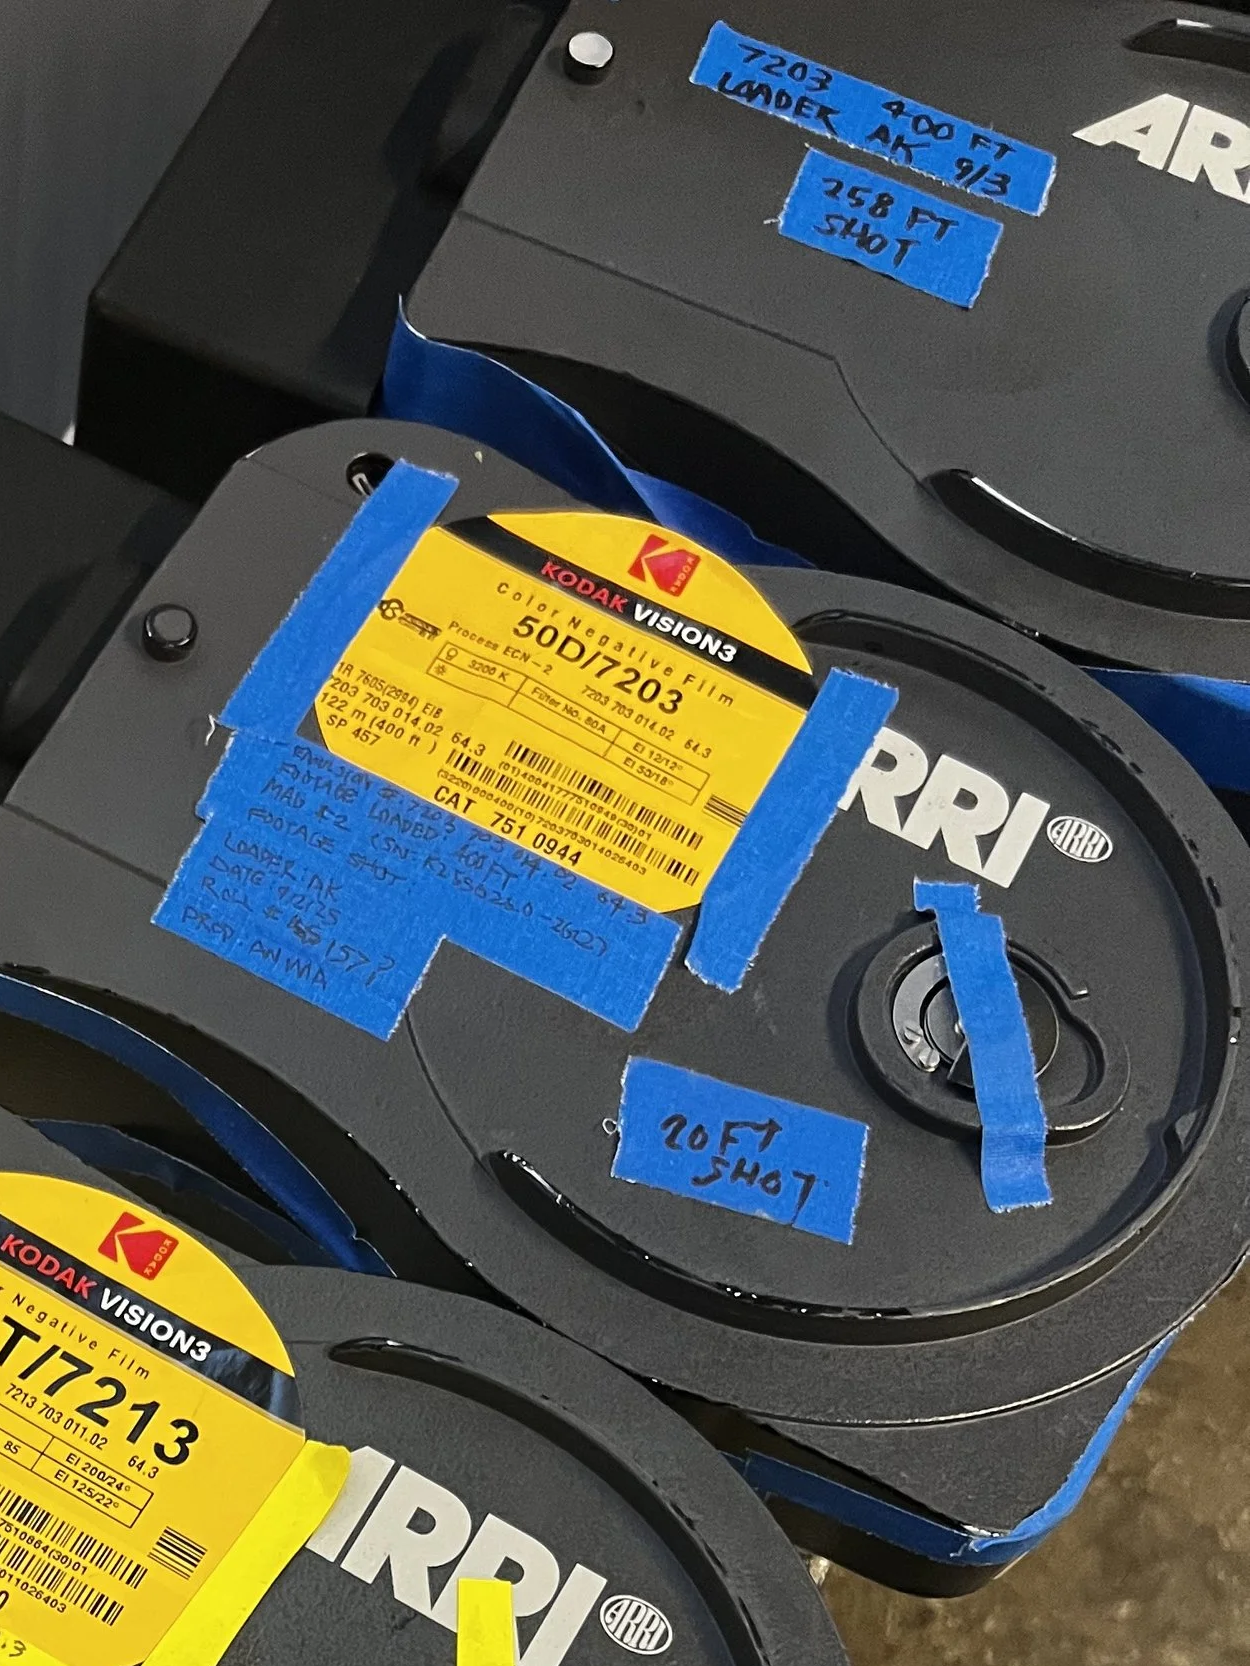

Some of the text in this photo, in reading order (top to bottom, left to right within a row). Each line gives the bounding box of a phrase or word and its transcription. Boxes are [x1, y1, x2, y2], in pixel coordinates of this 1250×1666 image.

[713, 69, 1013, 200] LOADER AK 9/3
[733, 42, 1019, 167] 7203 400 FT
[810, 207, 921, 274] SHOT
[816, 172, 960, 246] 258 FT
[668, 554, 698, 597] KODAK
[447, 620, 498, 651] Process
[496, 582, 733, 706] Color Negative Film
[542, 562, 736, 661] KODAK VISION3
[355, 669, 419, 710] 7605(2994)
[497, 671, 509, 681] K
[512, 615, 682, 714] 50D/7203
[320, 692, 348, 712] 122
[350, 708, 366, 721] m
[368, 715, 404, 738] (400
[326, 714, 380, 745] SP 457
[328, 673, 486, 756] 203 703 014.02 64.3
[581, 684, 711, 758] 7203 703 014.02 64.3
[243, 798, 338, 859] FOOTAGE
[433, 785, 581, 866] CAT 751 0944
[837, 726, 1050, 888] RRI
[660, 1113, 783, 1156] 20 FT
[690, 1155, 816, 1226] SHOT
[140, 1234, 175, 1280] KODAK
[1, 1235, 211, 1361] KODAK VISION3
[11, 1292, 97, 1350] Negative
[107, 1347, 149, 1379] Film
[3, 1440, 21, 1454] 85
[5, 1382, 159, 1478] 7213 703 011.02 64.3
[53, 1468, 69, 1482] EI
[65, 1452, 130, 1491] EI 200/24°
[597, 1589, 671, 1658] ARRI
